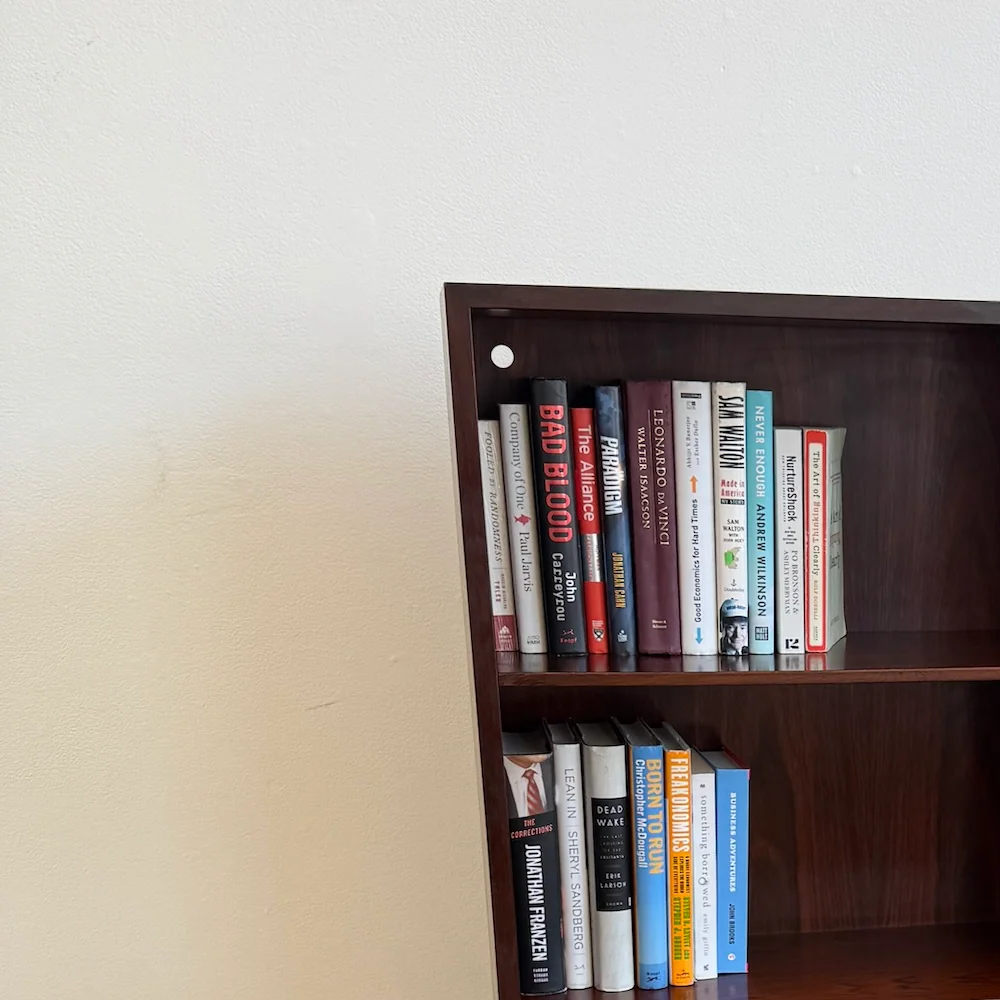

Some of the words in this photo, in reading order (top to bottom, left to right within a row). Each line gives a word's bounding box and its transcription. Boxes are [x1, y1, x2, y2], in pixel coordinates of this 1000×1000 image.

[718, 396, 744, 418] SAM
[755, 406, 765, 444] NEVER
[509, 412, 521, 468] Company
[540, 405, 566, 454] BAD
[578, 424, 592, 454] The
[638, 426, 648, 470] WALTER
[653, 410, 667, 488] LEONARDO
[719, 426, 744, 468] WALTON
[484, 432, 495, 474] FOOLED
[756, 448, 766, 498] ENOUGH
[514, 470, 525, 484] of
[580, 460, 595, 522] Alliance
[600, 435, 622, 516] PARADIGM
[786, 456, 798, 522] NurtureShock
[813, 488, 820, 498] of
[516, 485, 526, 510] One
[544, 463, 573, 542] BLOOD
[640, 475, 650, 529] ISAACSON
[658, 492, 664, 504] DA
[690, 498, 698, 523] Times
[489, 492, 502, 562] RANDOMNESS
[520, 532, 532, 556] Paul
[658, 506, 670, 545] VINCI
[756, 504, 766, 552] ANDREW
[612, 552, 624, 588] JONATHAN
[692, 546, 700, 558] for
[812, 546, 820, 576] Clearly
[521, 558, 534, 592] Jarvis
[552, 552, 566, 622] Carreyrou
[565, 572, 577, 602] John
[693, 560, 701, 601] Economics
[758, 557, 766, 617] WILKINSON
[694, 603, 702, 622] Good
[564, 768, 576, 802] LEAN
[635, 759, 647, 816] Christopher
[646, 759, 662, 808] BORN
[524, 818, 536, 828] THE
[566, 806, 576, 818] IN
[596, 818, 624, 827] WAKE
[597, 805, 624, 814] DEAD
[648, 810, 663, 834] TO
[670, 758, 690, 852] FREAKONOMICS
[700, 795, 710, 850] something
[510, 824, 553, 838] CORRECTIONS
[637, 818, 648, 868] McDougall
[525, 844, 544, 904] JONATHAN
[568, 831, 580, 879] SHERYL
[648, 838, 664, 874] RUN
[529, 906, 548, 961] FRANZEN
[570, 883, 584, 950] SANDBERG
